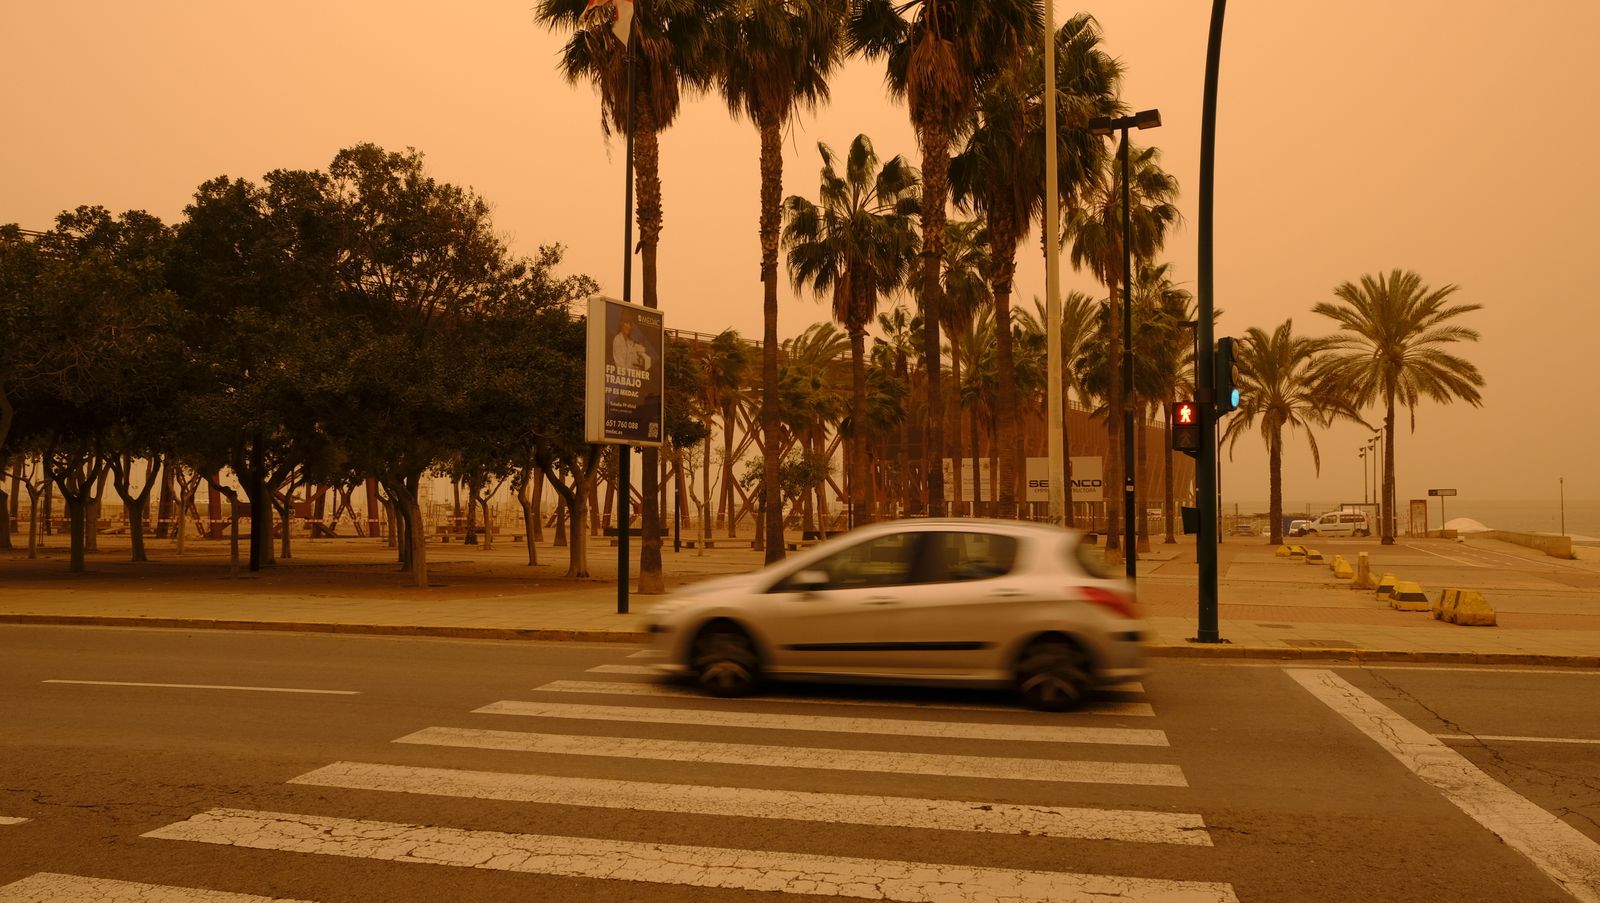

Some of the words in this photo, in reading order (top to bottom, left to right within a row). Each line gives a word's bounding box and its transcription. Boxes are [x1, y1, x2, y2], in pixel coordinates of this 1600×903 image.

[606, 364, 615, 374] FP
[617, 366, 626, 376] ES
[626, 368, 650, 380] TENER
[605, 374, 642, 388] TRABAJO
[605, 386, 612, 394] FP
[620, 389, 639, 398] MEDAC
[605, 419, 616, 427] 651
[617, 420, 628, 428] 760
[628, 421, 639, 429] 088
